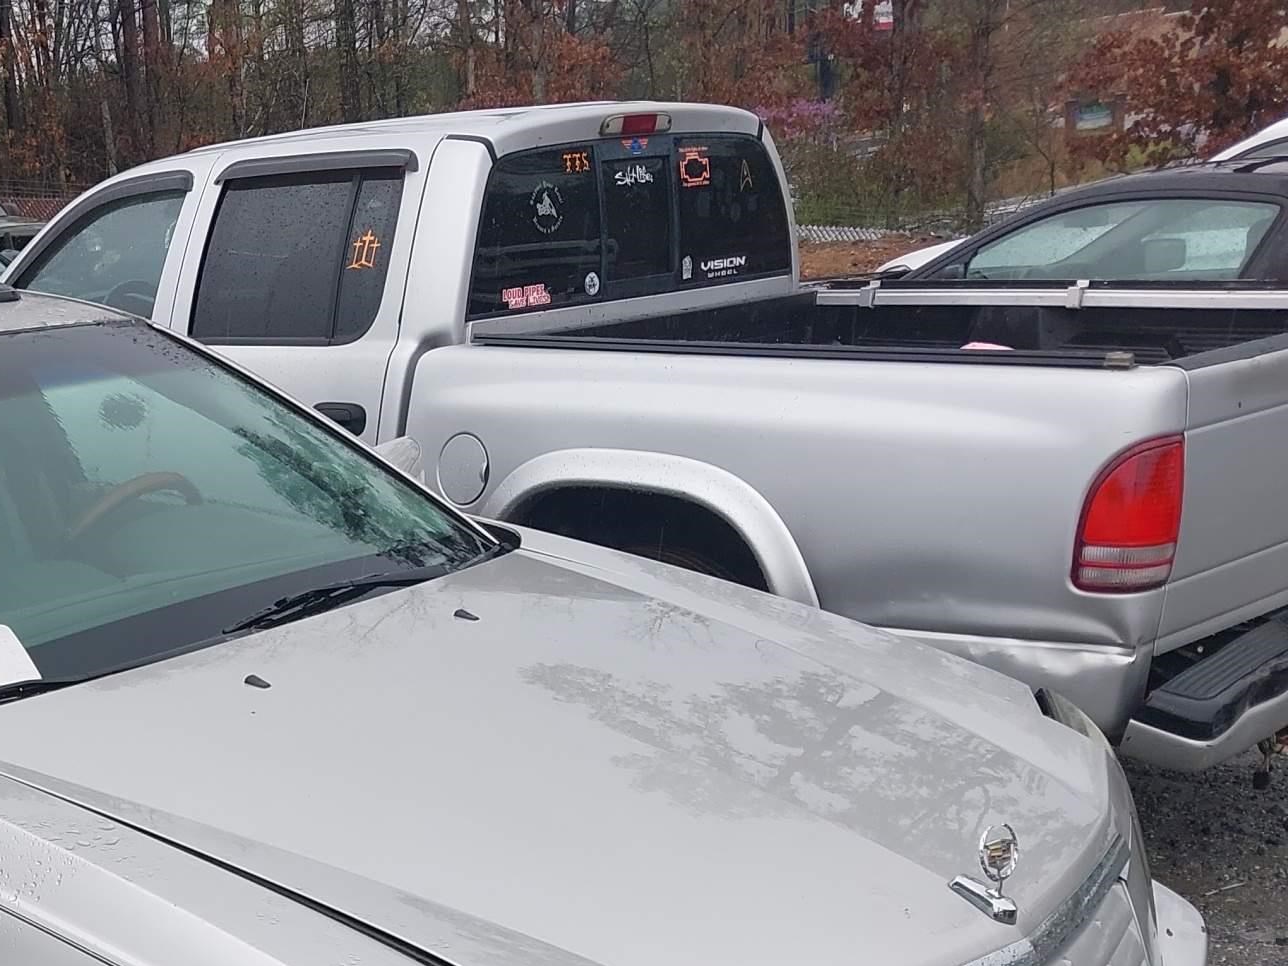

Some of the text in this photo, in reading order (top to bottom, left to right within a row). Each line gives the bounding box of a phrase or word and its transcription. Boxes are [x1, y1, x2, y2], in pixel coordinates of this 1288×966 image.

[700, 255, 747, 271] VISION
[707, 268, 739, 278] WHEEL
[502, 284, 545, 301] LOUD PIPES
[508, 297, 527, 308] SAVE
